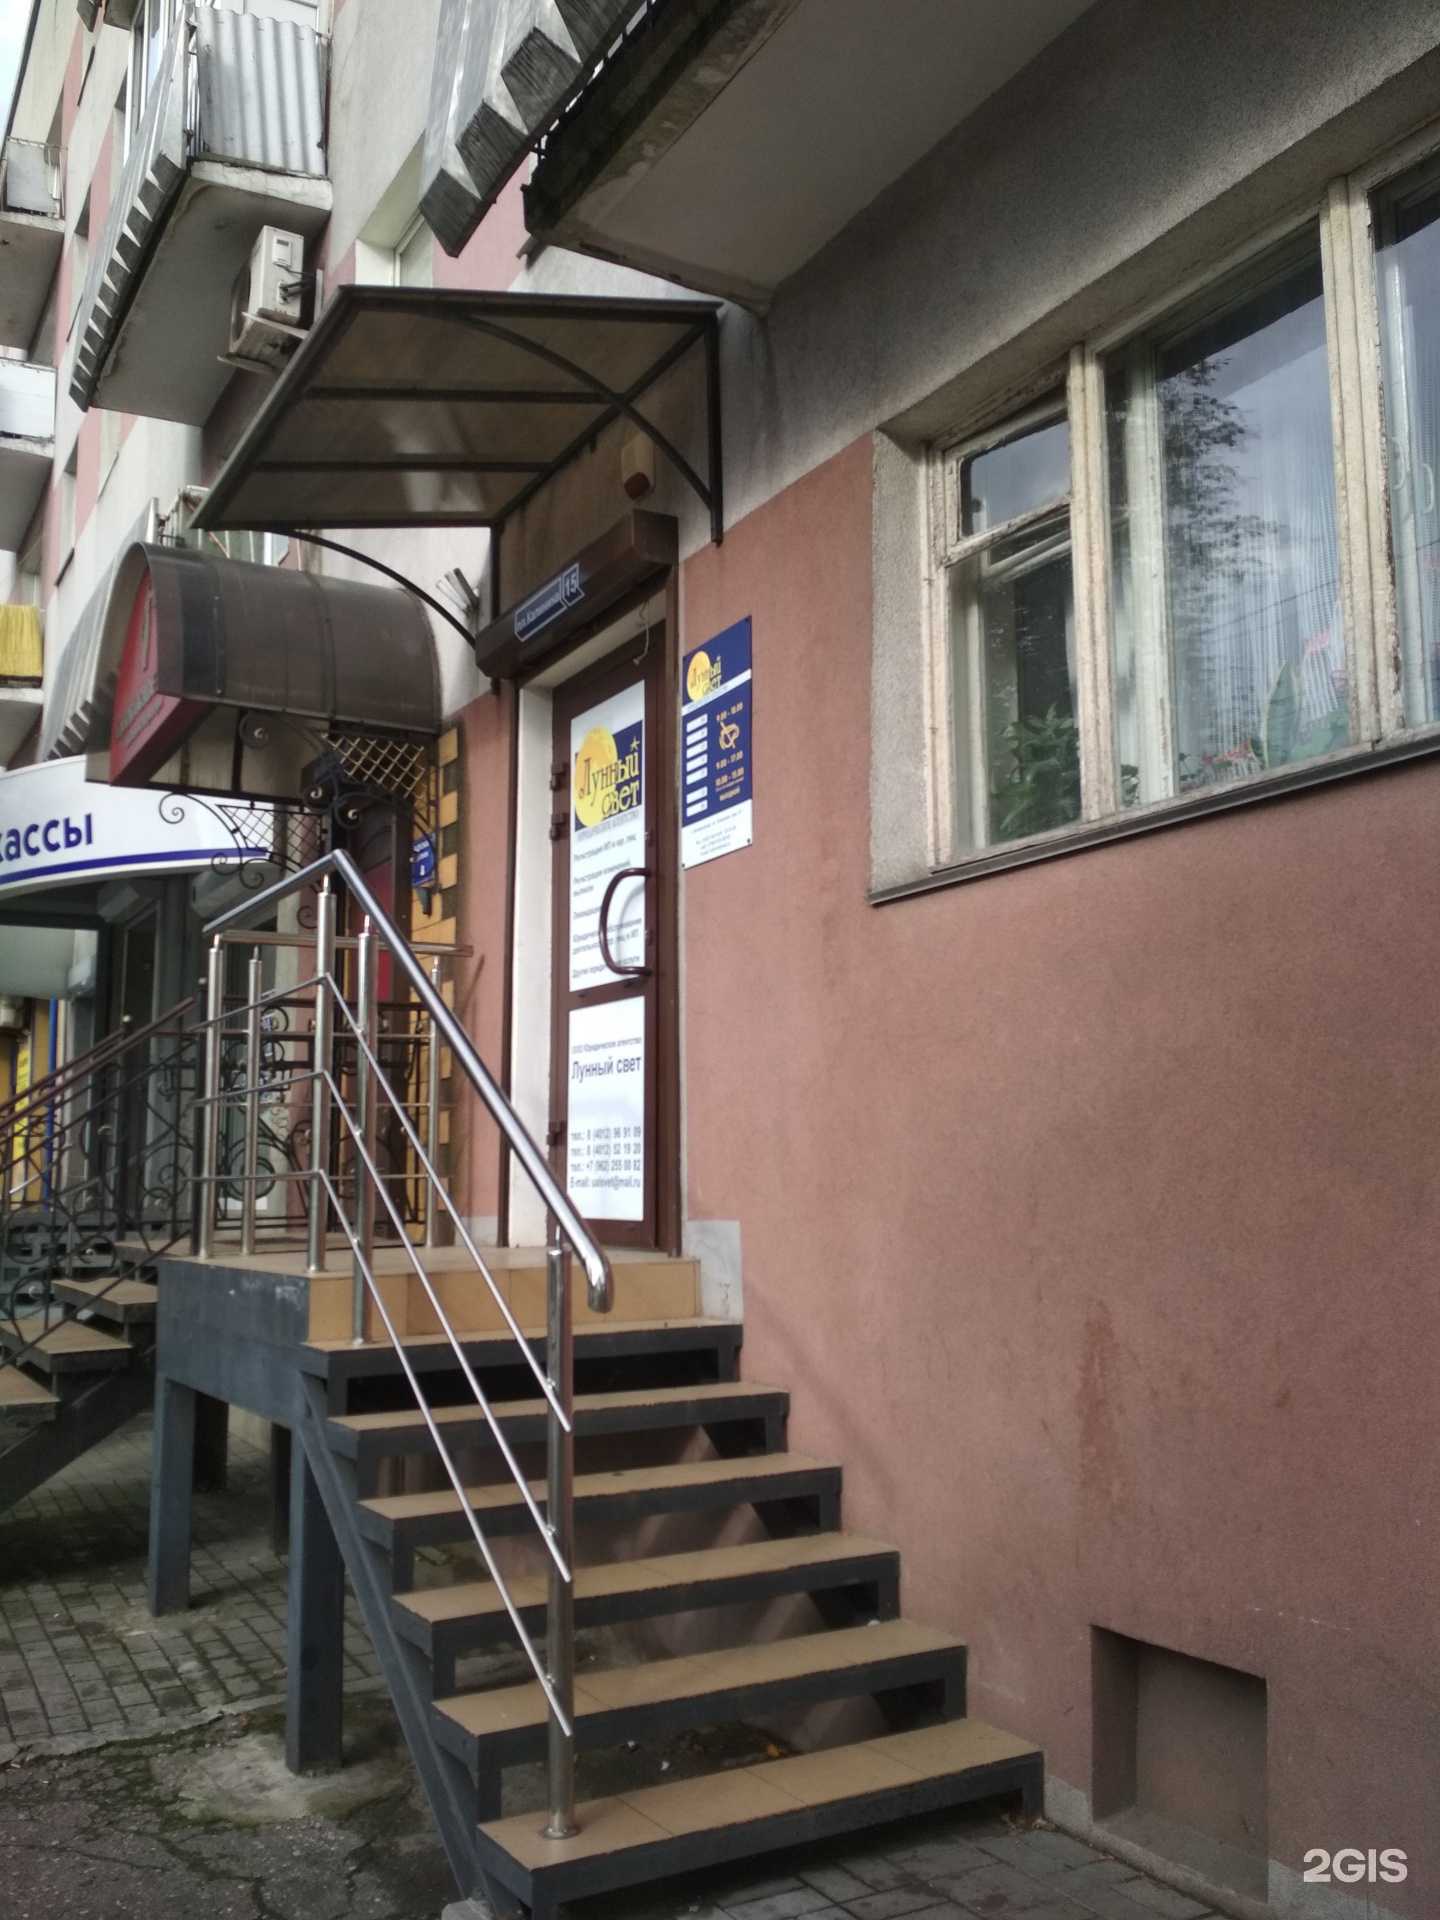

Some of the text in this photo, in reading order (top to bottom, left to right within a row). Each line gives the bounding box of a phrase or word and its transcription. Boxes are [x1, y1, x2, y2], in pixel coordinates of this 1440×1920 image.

[565, 573, 578, 596] 15
[578, 752, 640, 806] Лунный
[601, 779, 640, 818] свет
[0, 813, 93, 863] ассы
[571, 1056, 642, 1084] Лунный свет
